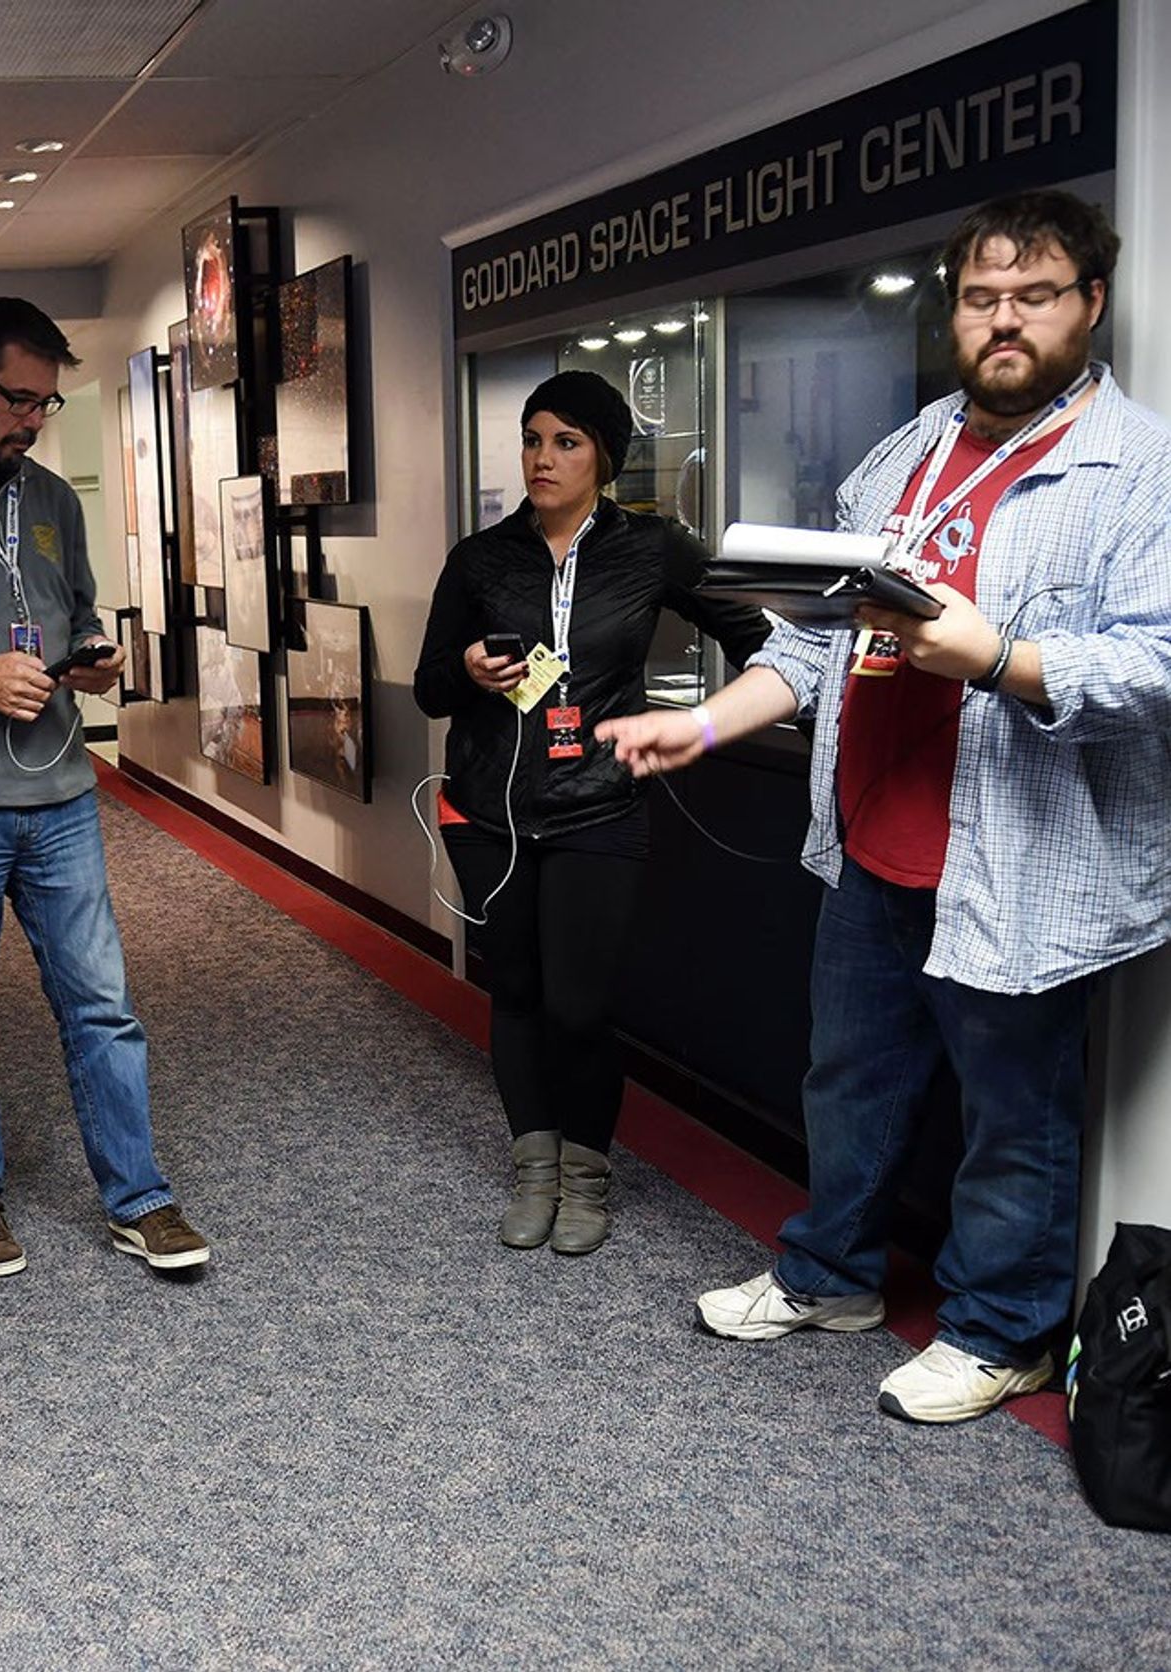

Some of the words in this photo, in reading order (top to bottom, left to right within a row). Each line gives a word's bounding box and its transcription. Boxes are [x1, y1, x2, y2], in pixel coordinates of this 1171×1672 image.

[462, 231, 580, 311] GODDARD
[589, 192, 692, 274] SPACE
[704, 139, 843, 241] FLIGHT
[859, 61, 1084, 195] CENTER
